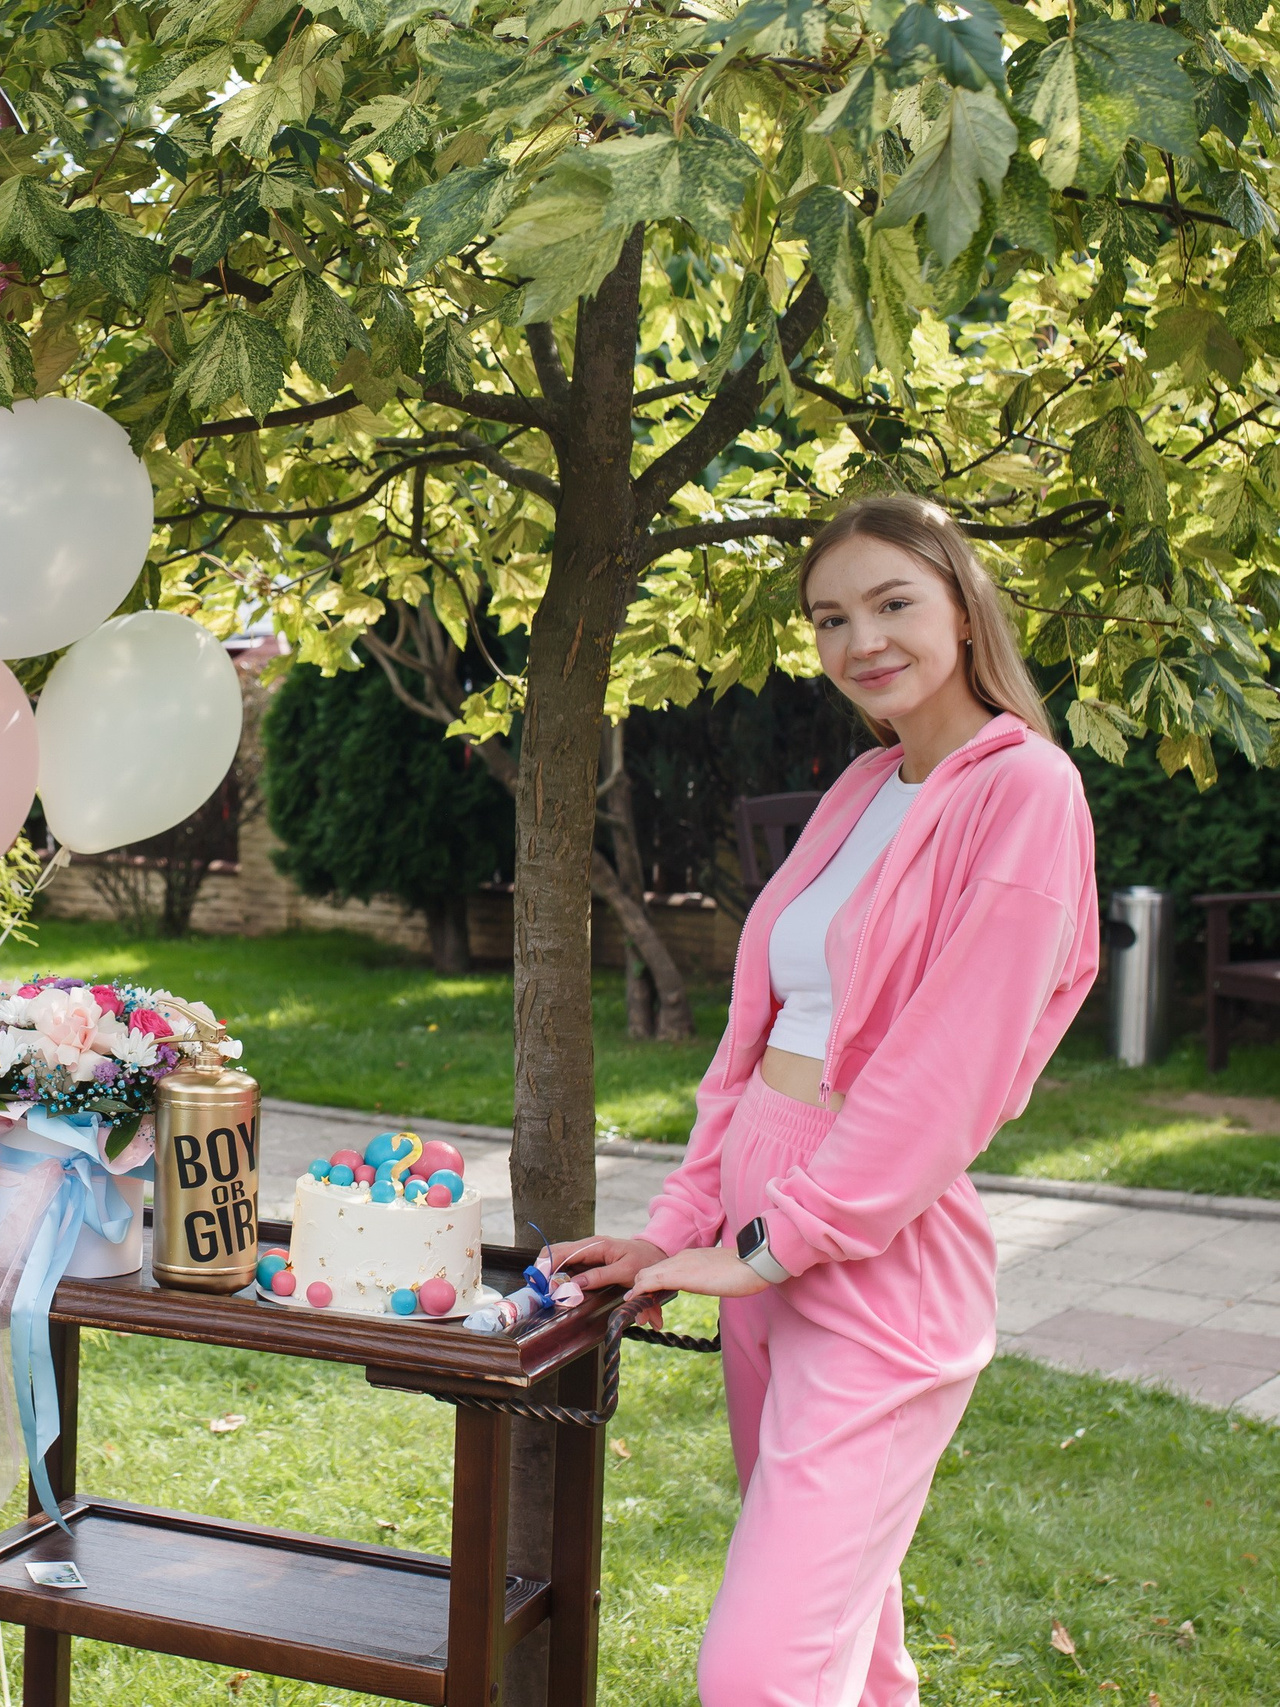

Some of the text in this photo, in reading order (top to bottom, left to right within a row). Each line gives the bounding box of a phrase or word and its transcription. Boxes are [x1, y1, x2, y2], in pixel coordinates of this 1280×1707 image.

[173, 1115, 256, 1190] BOY
[391, 1132, 423, 1198] ?
[211, 1180, 245, 1205] OR
